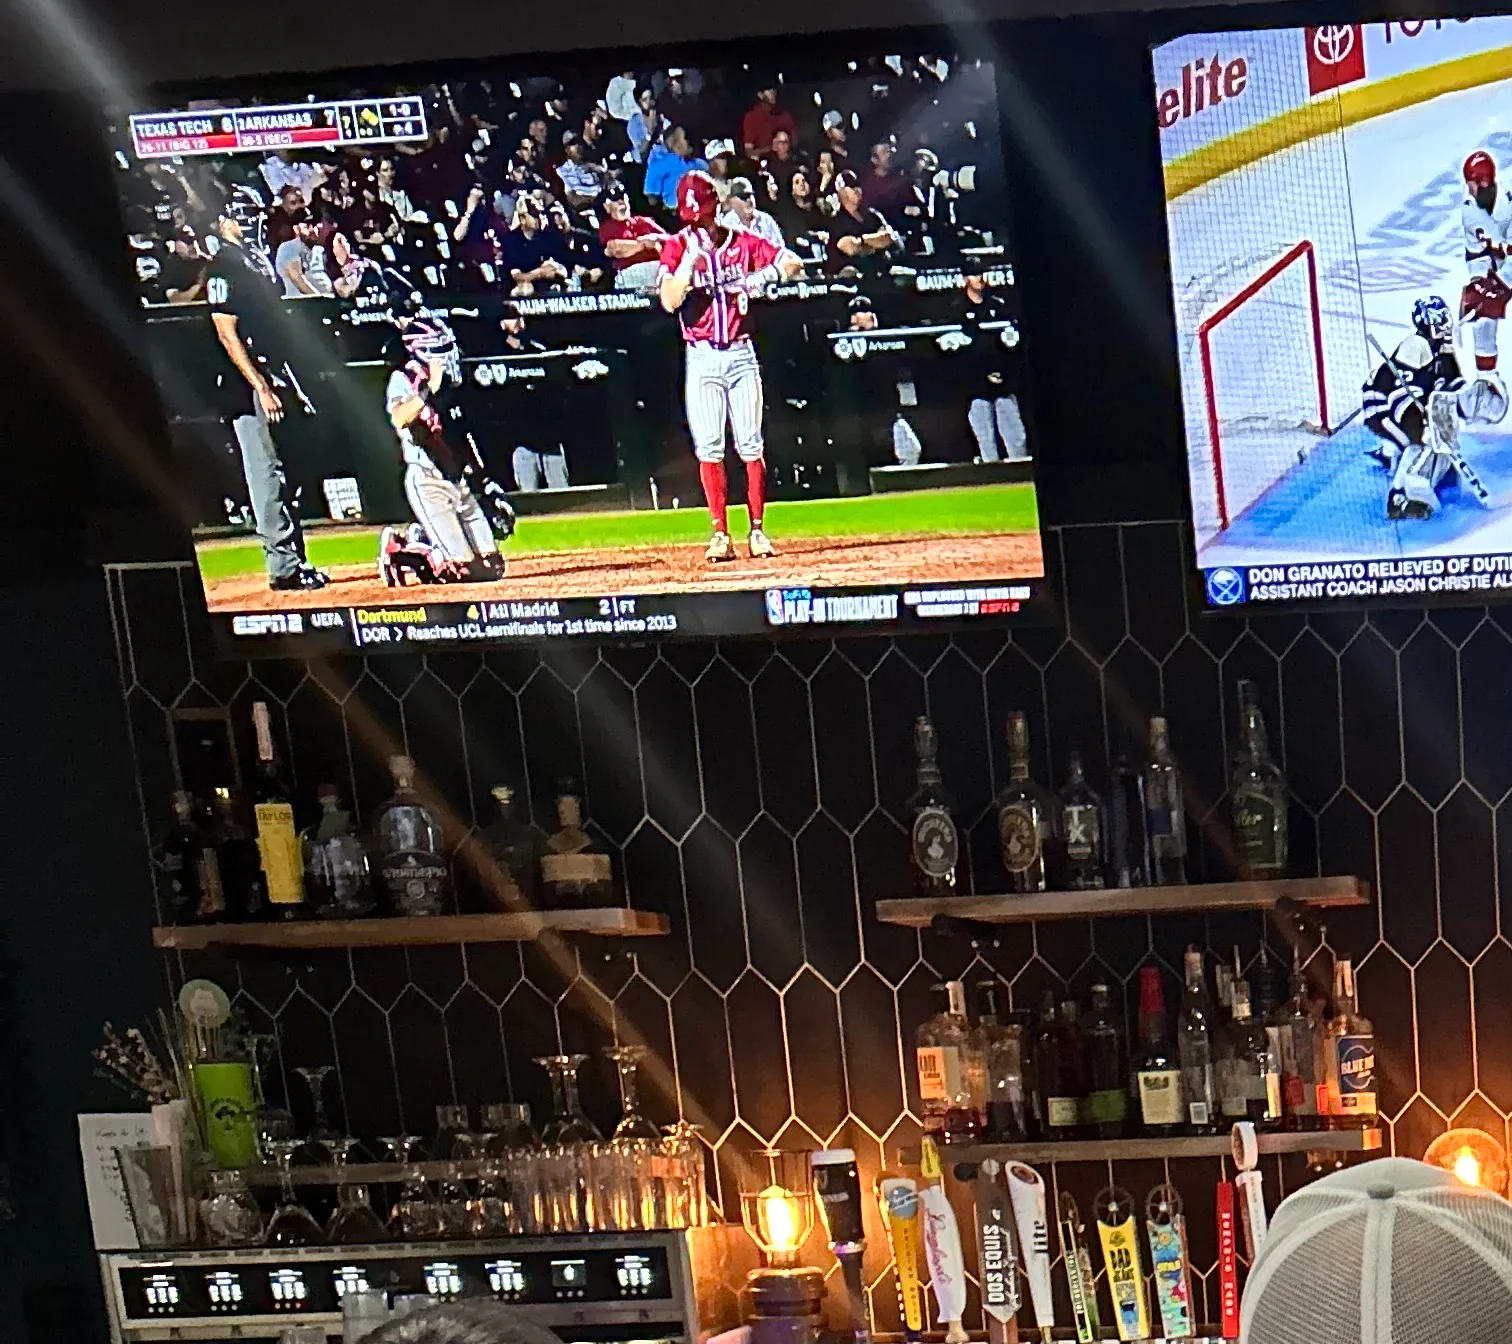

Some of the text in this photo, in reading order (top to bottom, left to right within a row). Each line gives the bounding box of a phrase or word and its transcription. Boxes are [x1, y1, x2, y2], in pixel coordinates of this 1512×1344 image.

[136, 122, 176, 137] TEXAS
[178, 119, 212, 135] TECH
[1249, 567, 1285, 584] DON
[1287, 563, 1365, 581] GRANATO
[1368, 559, 1443, 578] RELIEVED
[1447, 557, 1471, 573] OF
[1250, 582, 1325, 600] ASSISTANT
[1326, 579, 1377, 597] COACH
[1379, 577, 1426, 595] JASON
[1427, 573, 1491, 592] CHRISTIE
[310, 612, 345, 628] UEFA
[357, 598, 637, 625] Dortmund 4 Atl Madrid 2 FT
[826, 593, 899, 622] TOURNAMENT
[361, 614, 678, 645] DOR Reaches UCL semifinals for 1st time since 2013
[983, 1224, 1005, 1303] DOS EQUIS
